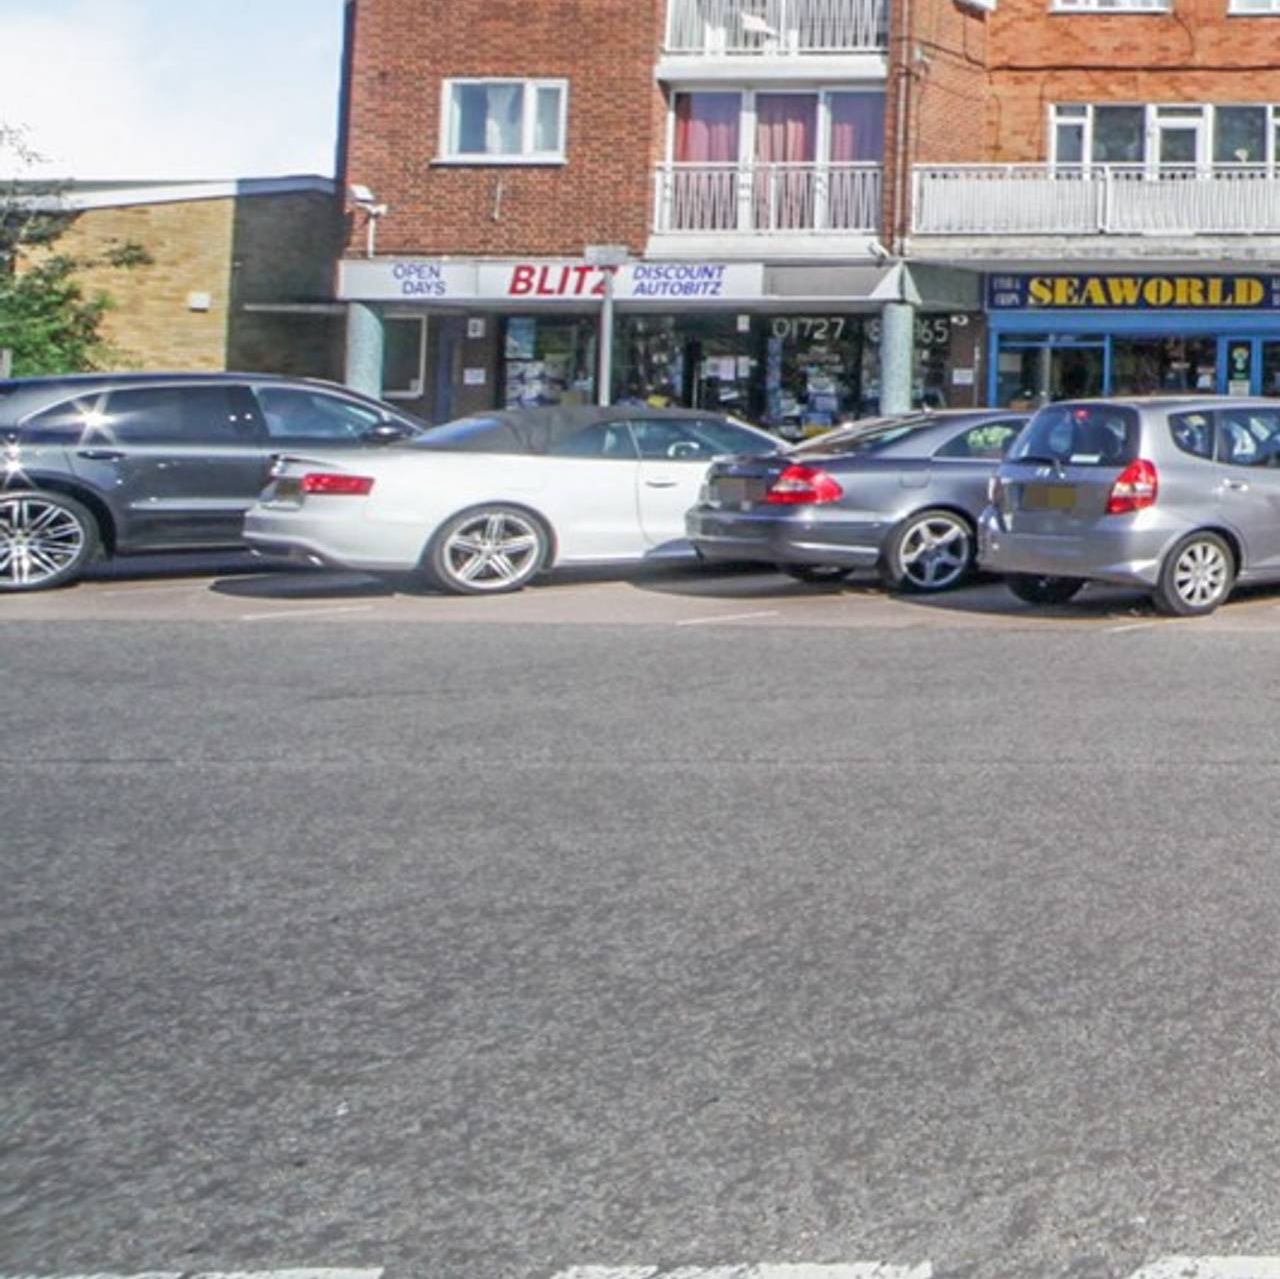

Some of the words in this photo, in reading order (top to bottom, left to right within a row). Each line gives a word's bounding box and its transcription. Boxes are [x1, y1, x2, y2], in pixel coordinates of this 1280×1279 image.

[393, 263, 441, 280] OPEN
[508, 264, 619, 295] BLITZ
[633, 264, 726, 280] DISCOUNT
[402, 280, 446, 295] DAYS
[633, 281, 722, 296] AUTOBITZ
[1028, 276, 1264, 306] SEAWORLD
[772, 317, 845, 339] 01727
